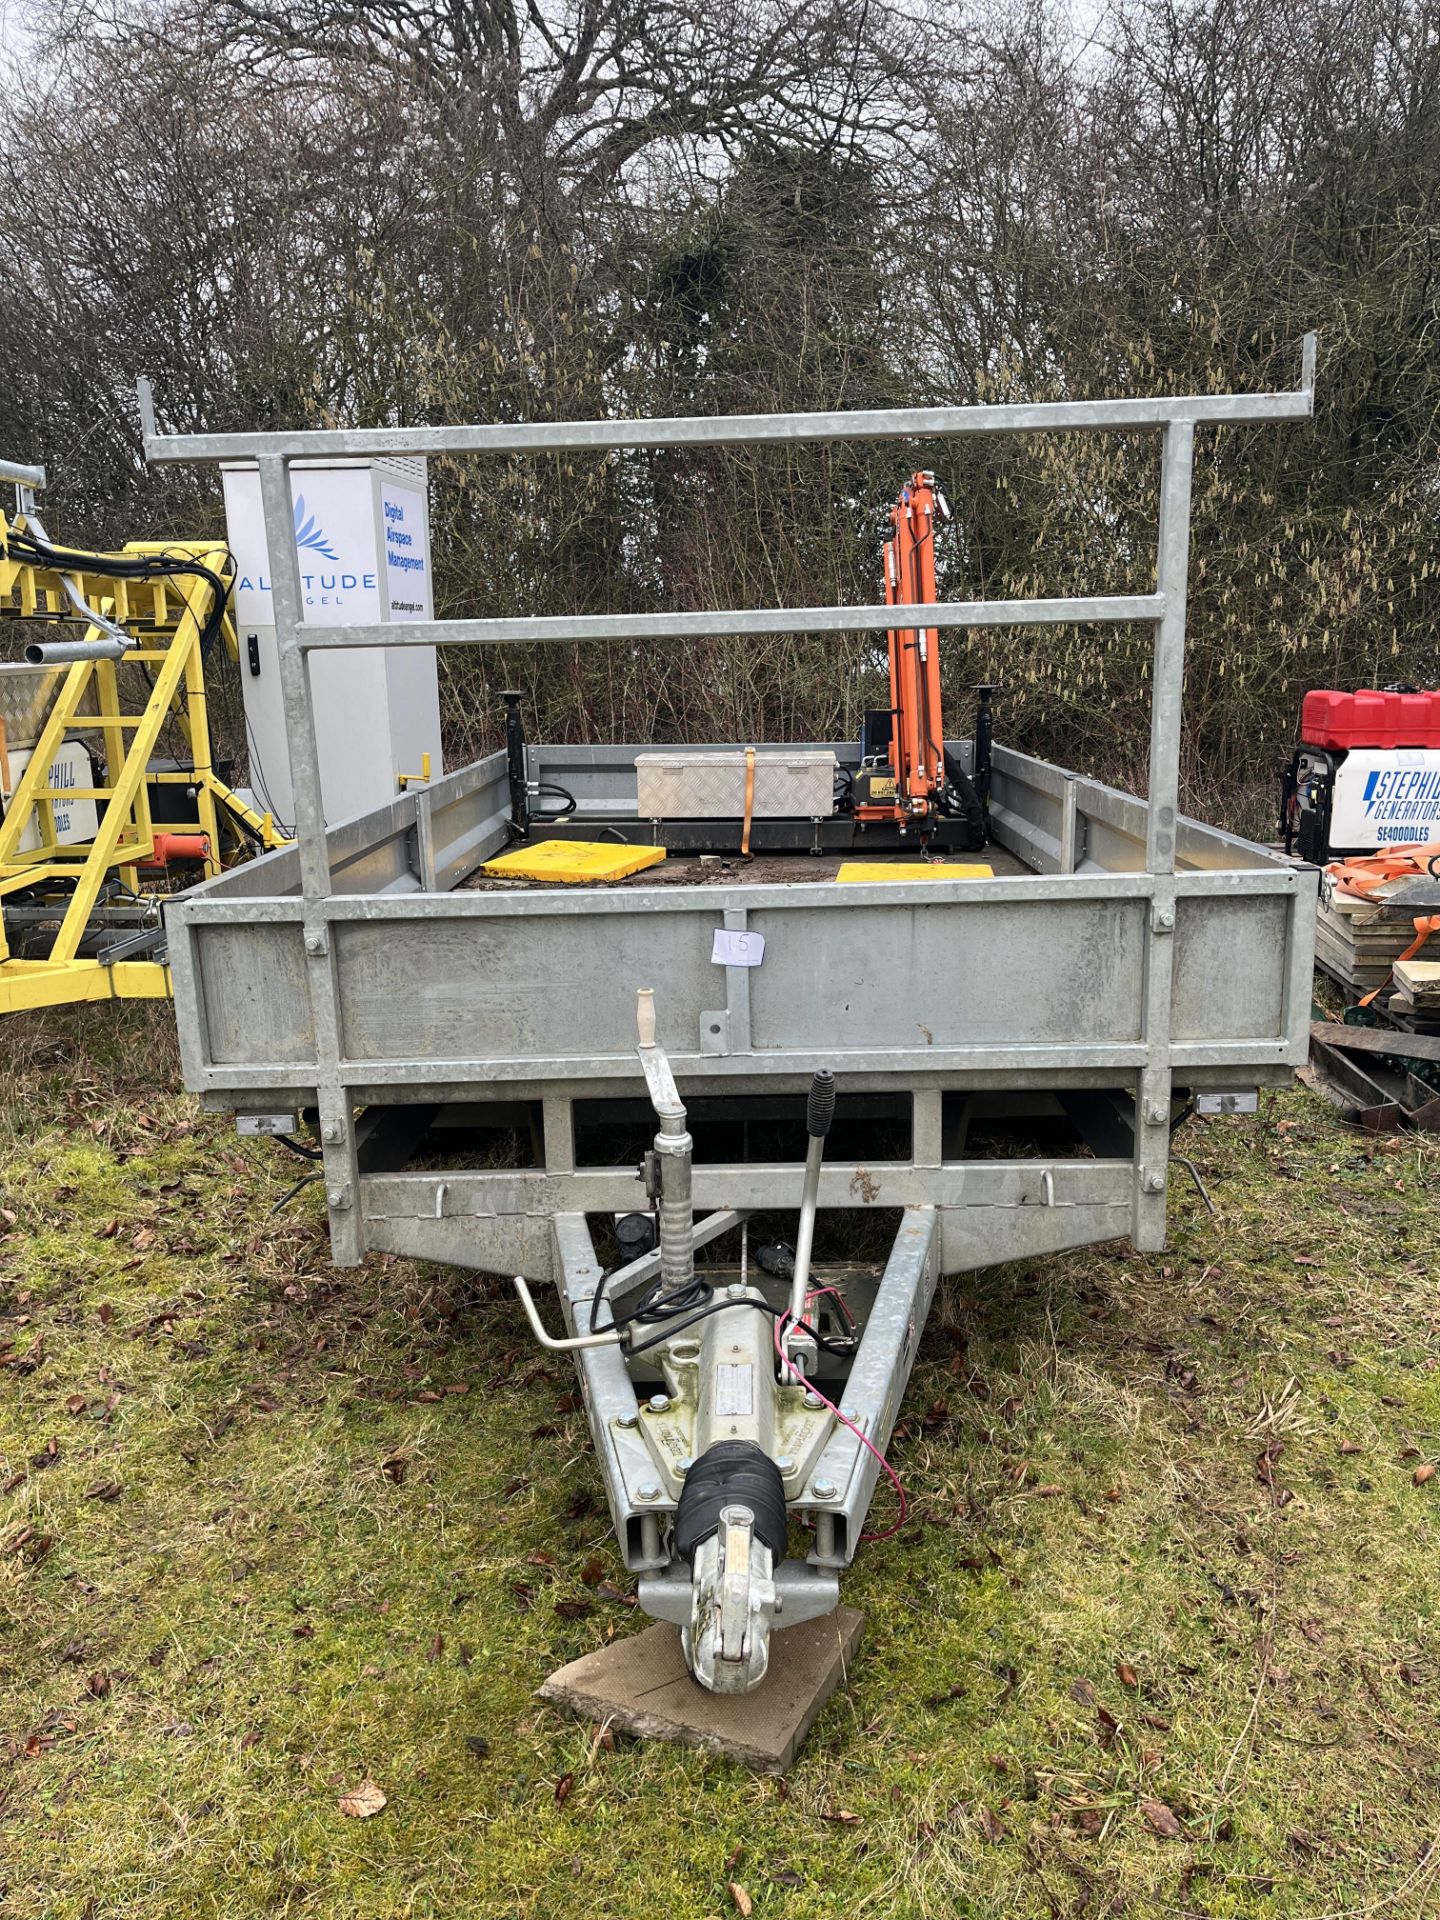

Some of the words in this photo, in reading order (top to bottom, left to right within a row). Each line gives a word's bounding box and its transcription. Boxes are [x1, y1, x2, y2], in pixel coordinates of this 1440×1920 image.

[384, 501, 404, 523] Digital
[387, 526, 412, 548] Airspace
[388, 550, 424, 572] Management
[239, 574, 377, 591] ALTUDE
[1376, 771, 1440, 799] STEPHIL
